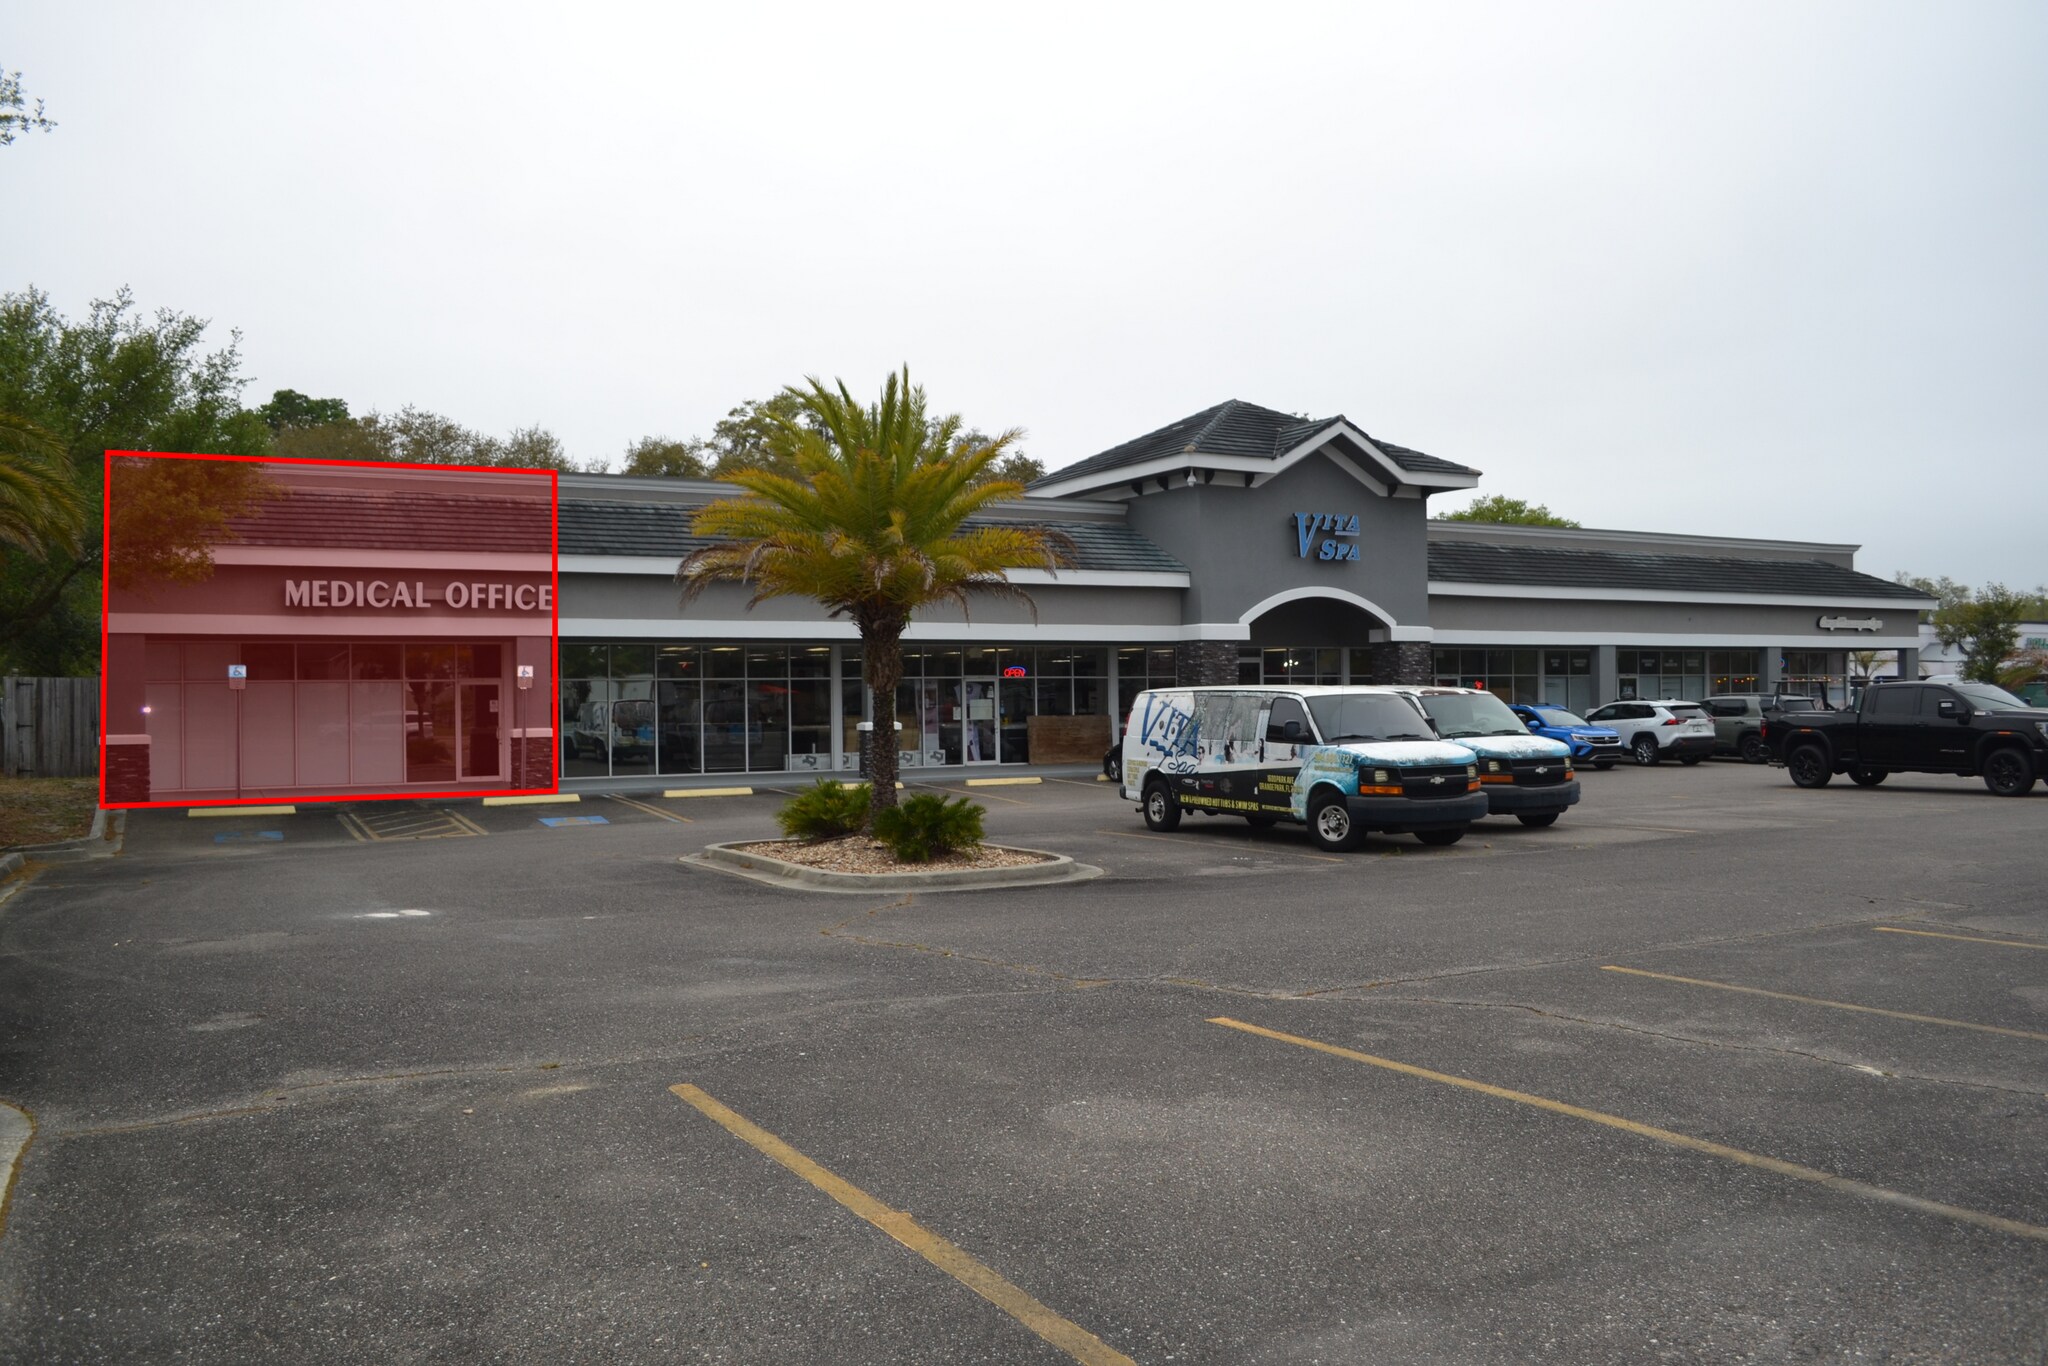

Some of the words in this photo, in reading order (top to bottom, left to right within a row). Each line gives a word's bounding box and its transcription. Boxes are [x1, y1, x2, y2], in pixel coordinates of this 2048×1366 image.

[1294, 511, 1360, 559] VITA
[1319, 538, 1361, 561] SPA
[285, 579, 432, 608] MEDICAL
[445, 581, 553, 611] OFFICE
[1004, 668, 1025, 678] OPEN
[1141, 692, 1199, 760] VITA
[1167, 750, 1199, 777] Spa
[1235, 800, 1248, 810] SWIM
[1248, 801, 1259, 811] SPAS
